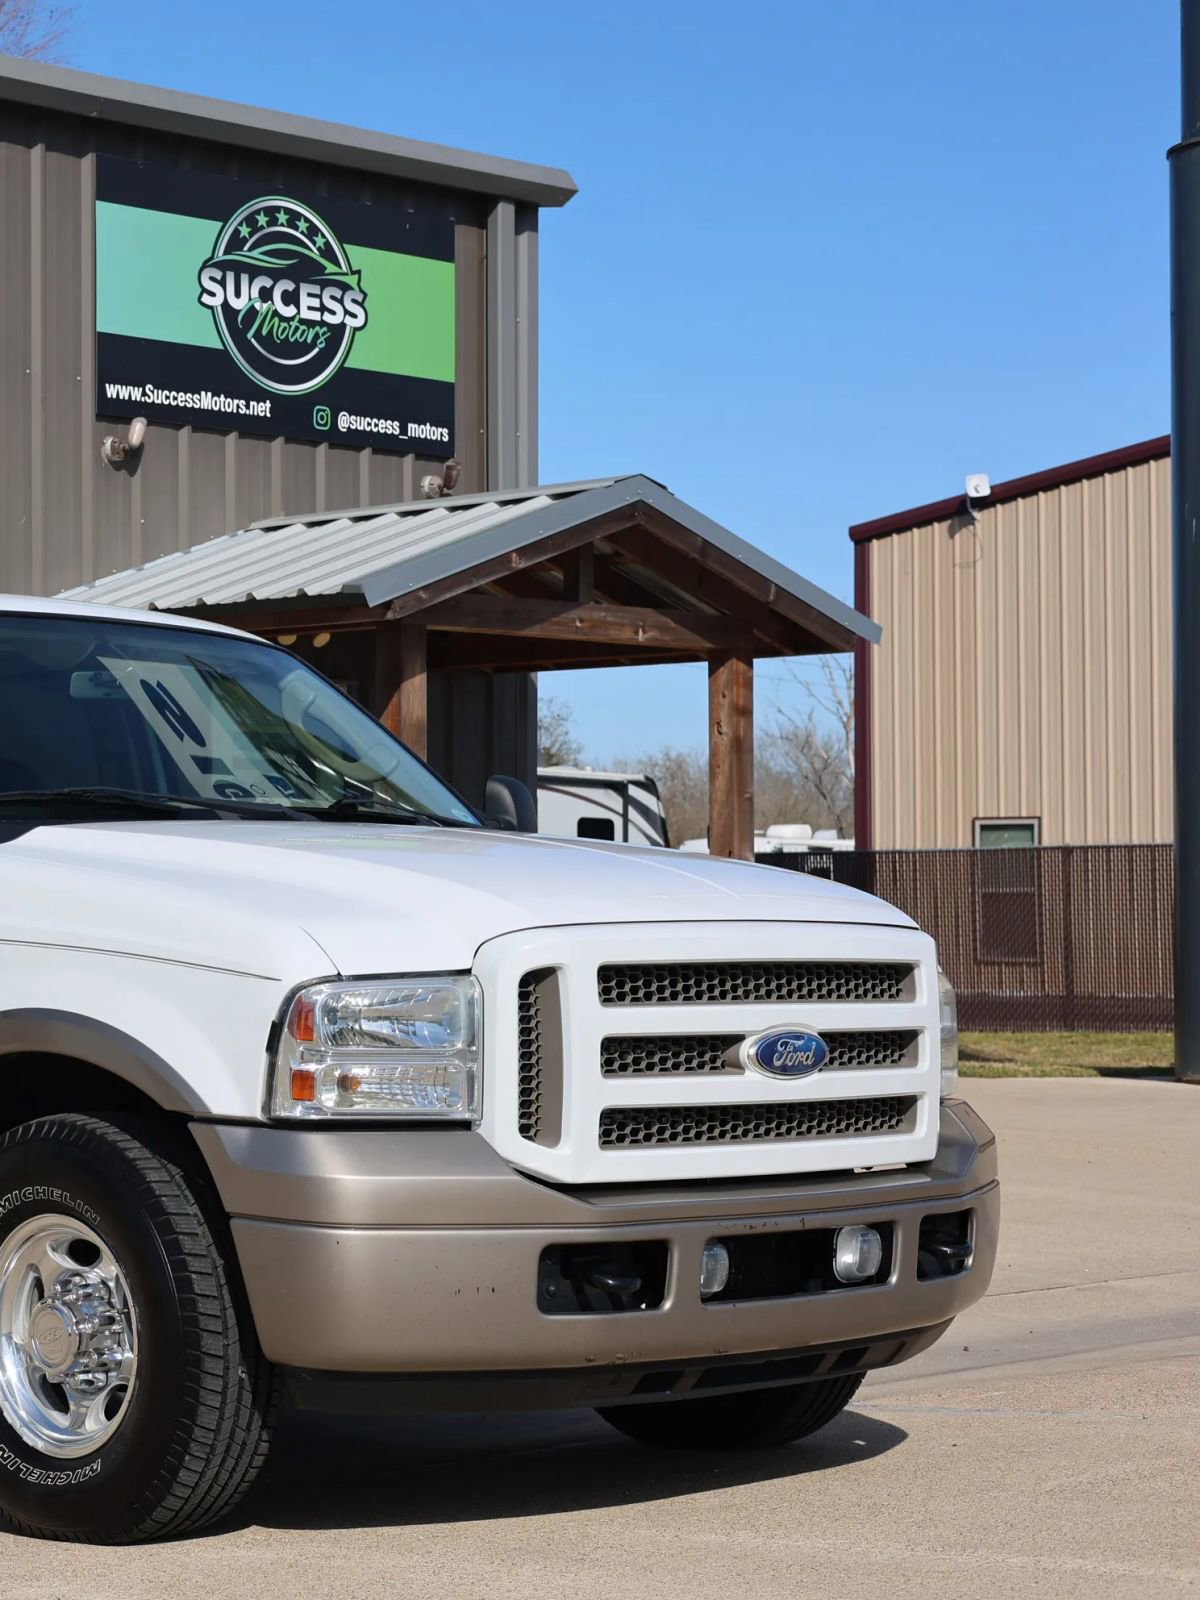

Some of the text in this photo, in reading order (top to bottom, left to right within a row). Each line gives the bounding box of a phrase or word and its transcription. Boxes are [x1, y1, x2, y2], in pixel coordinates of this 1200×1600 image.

[200, 267, 366, 328] SUCCESS
[238, 297, 331, 349] Motors
[105, 383, 271, 417] www.SuccessMotors.net
[338, 411, 449, 442] @success_motors
[773, 1038, 816, 1066] Ford
